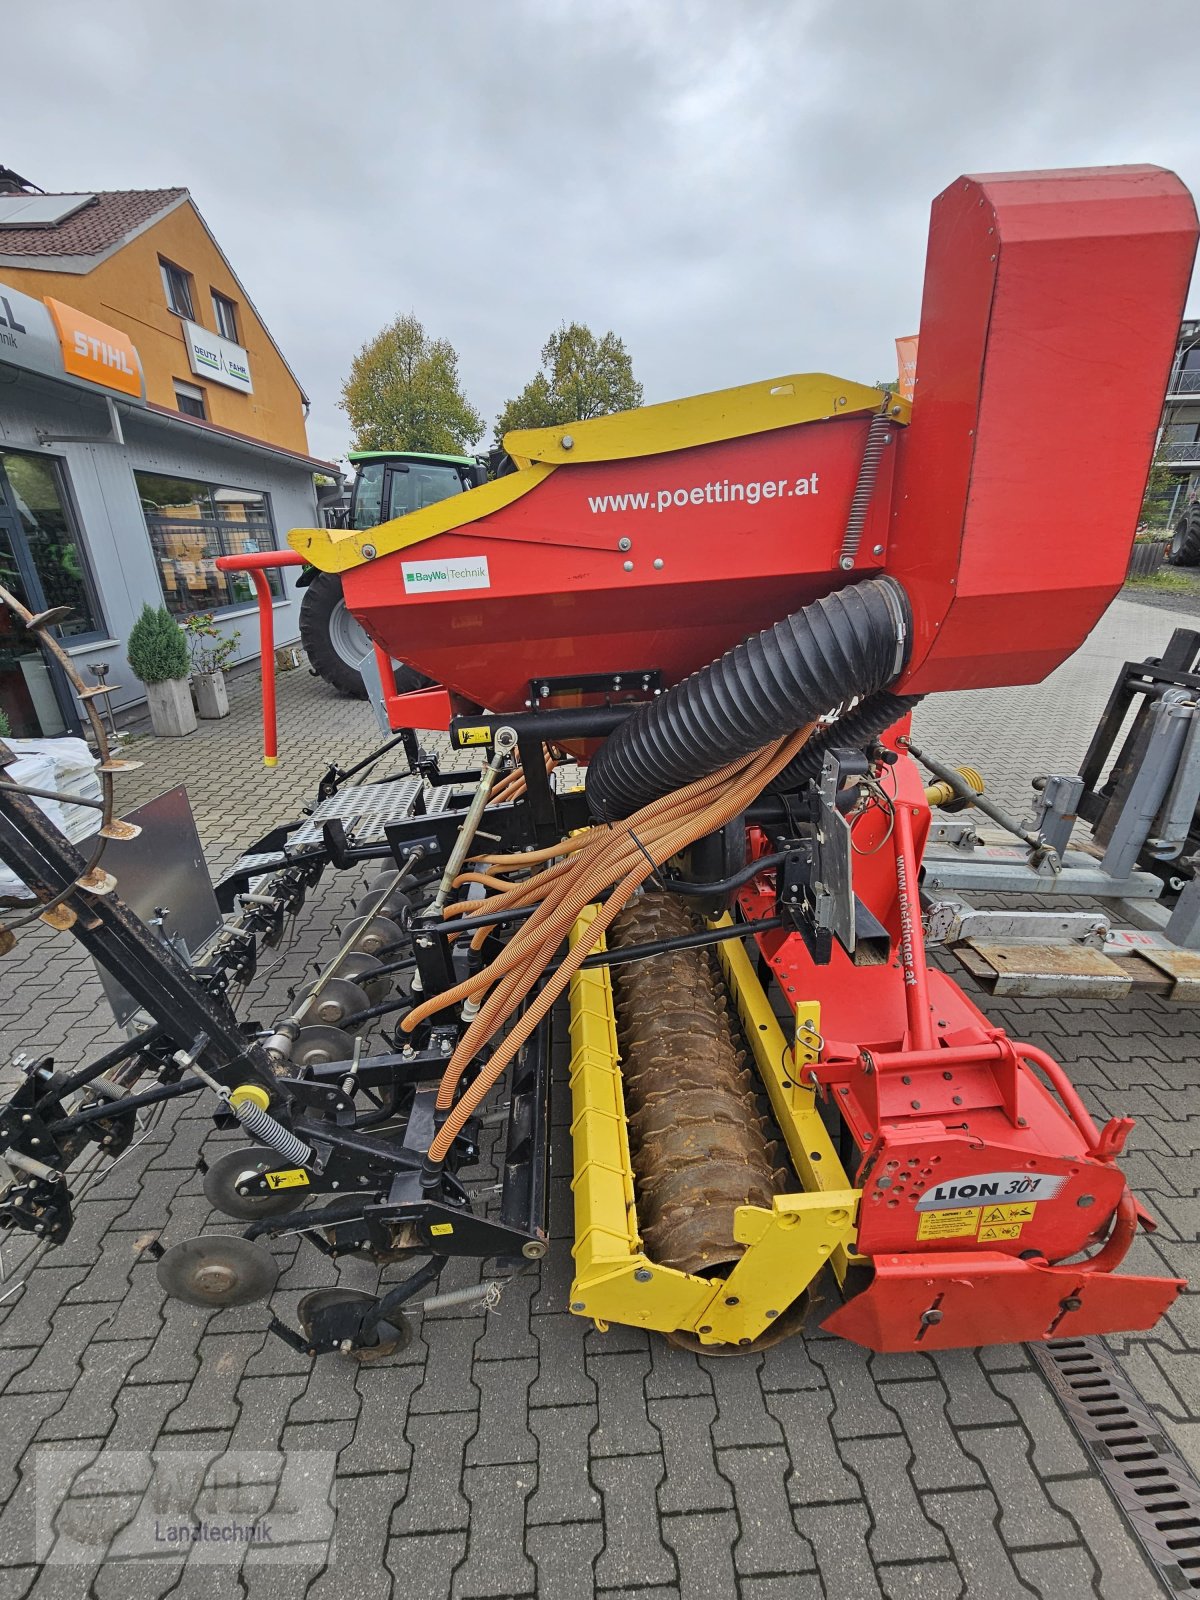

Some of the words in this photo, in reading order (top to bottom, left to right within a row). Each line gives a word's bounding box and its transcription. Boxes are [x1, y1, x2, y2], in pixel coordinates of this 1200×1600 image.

[74, 330, 133, 375] STIHL
[194, 345, 217, 361] DEUTZ
[229, 362, 246, 374] FAHR
[588, 473, 819, 513] www.poettinger.at
[415, 571, 447, 582] BayWa
[450, 567, 486, 579] Technik
[896, 855, 917, 986] www.poettinger.at
[934, 1182, 999, 1201] LION
[1004, 1178, 1042, 1195] 301
